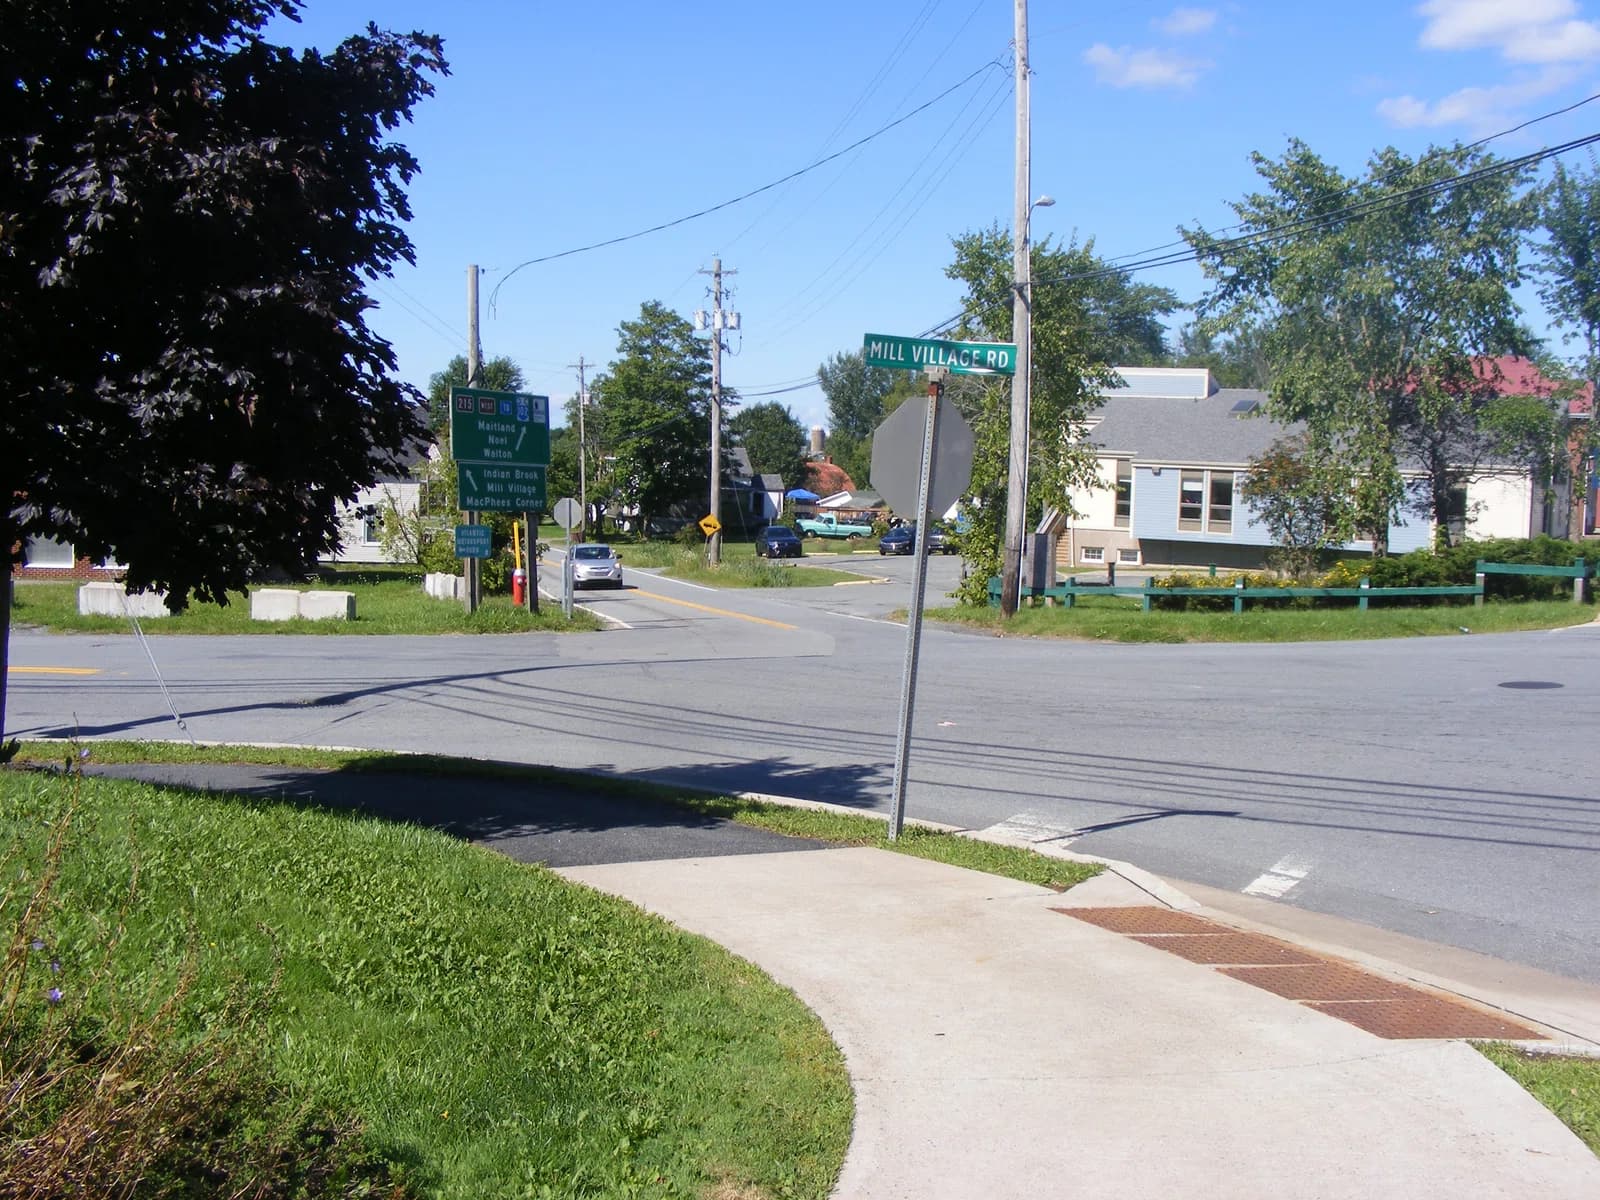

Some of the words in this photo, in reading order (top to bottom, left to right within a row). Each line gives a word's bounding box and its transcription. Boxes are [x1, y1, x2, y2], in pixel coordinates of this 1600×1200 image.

[870, 340, 905, 361] MILL
[912, 345, 980, 368] VILLAGE
[987, 350, 1009, 369] RD
[458, 398, 472, 409] 215
[478, 420, 515, 433] Maitland
[488, 434, 507, 445] Noel
[483, 447, 512, 458] Walton
[483, 469, 511, 479] Indian
[514, 470, 538, 480] Brook
[487, 483, 503, 493] Mill
[507, 484, 536, 496] Village
[466, 496, 511, 507] MacPhees
[515, 498, 543, 508] Corner
